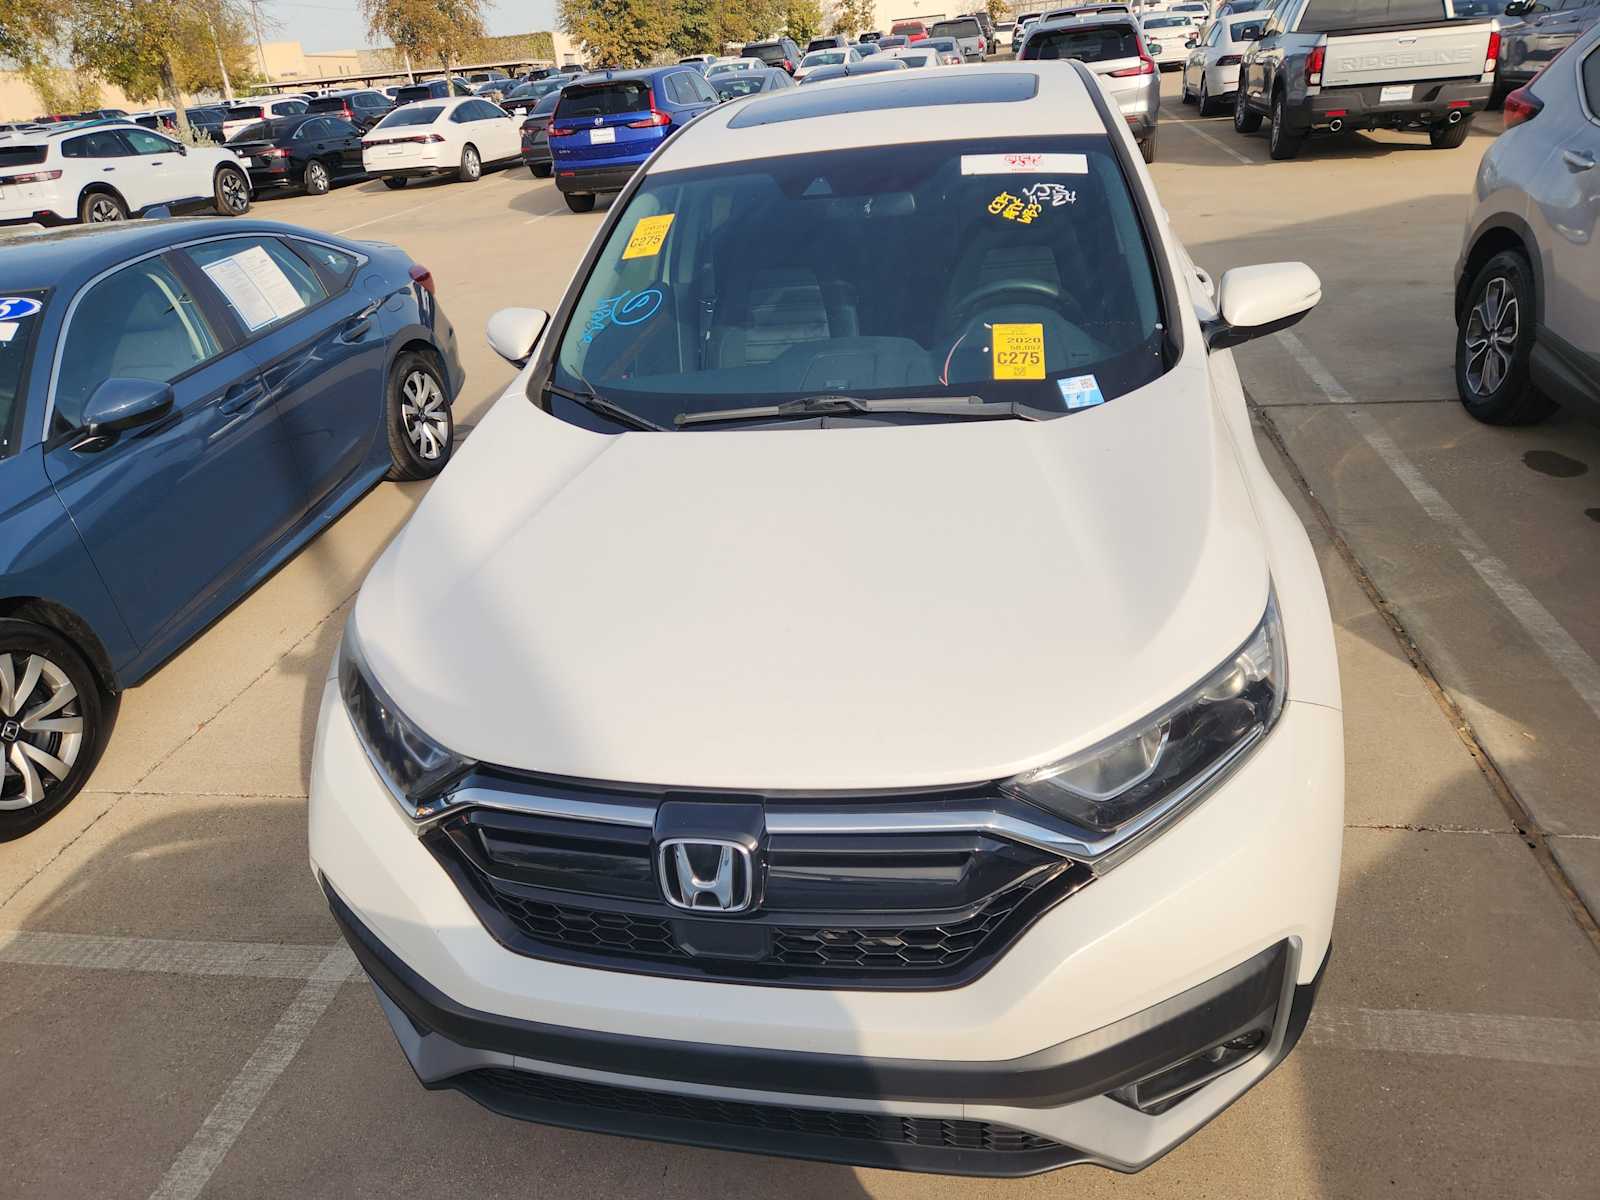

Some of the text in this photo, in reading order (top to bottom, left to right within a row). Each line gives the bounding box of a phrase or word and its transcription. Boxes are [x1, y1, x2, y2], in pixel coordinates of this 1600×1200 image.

[1341, 50, 1472, 71] RIDGELINE
[630, 235, 661, 249] C275
[997, 351, 1040, 365] C275
